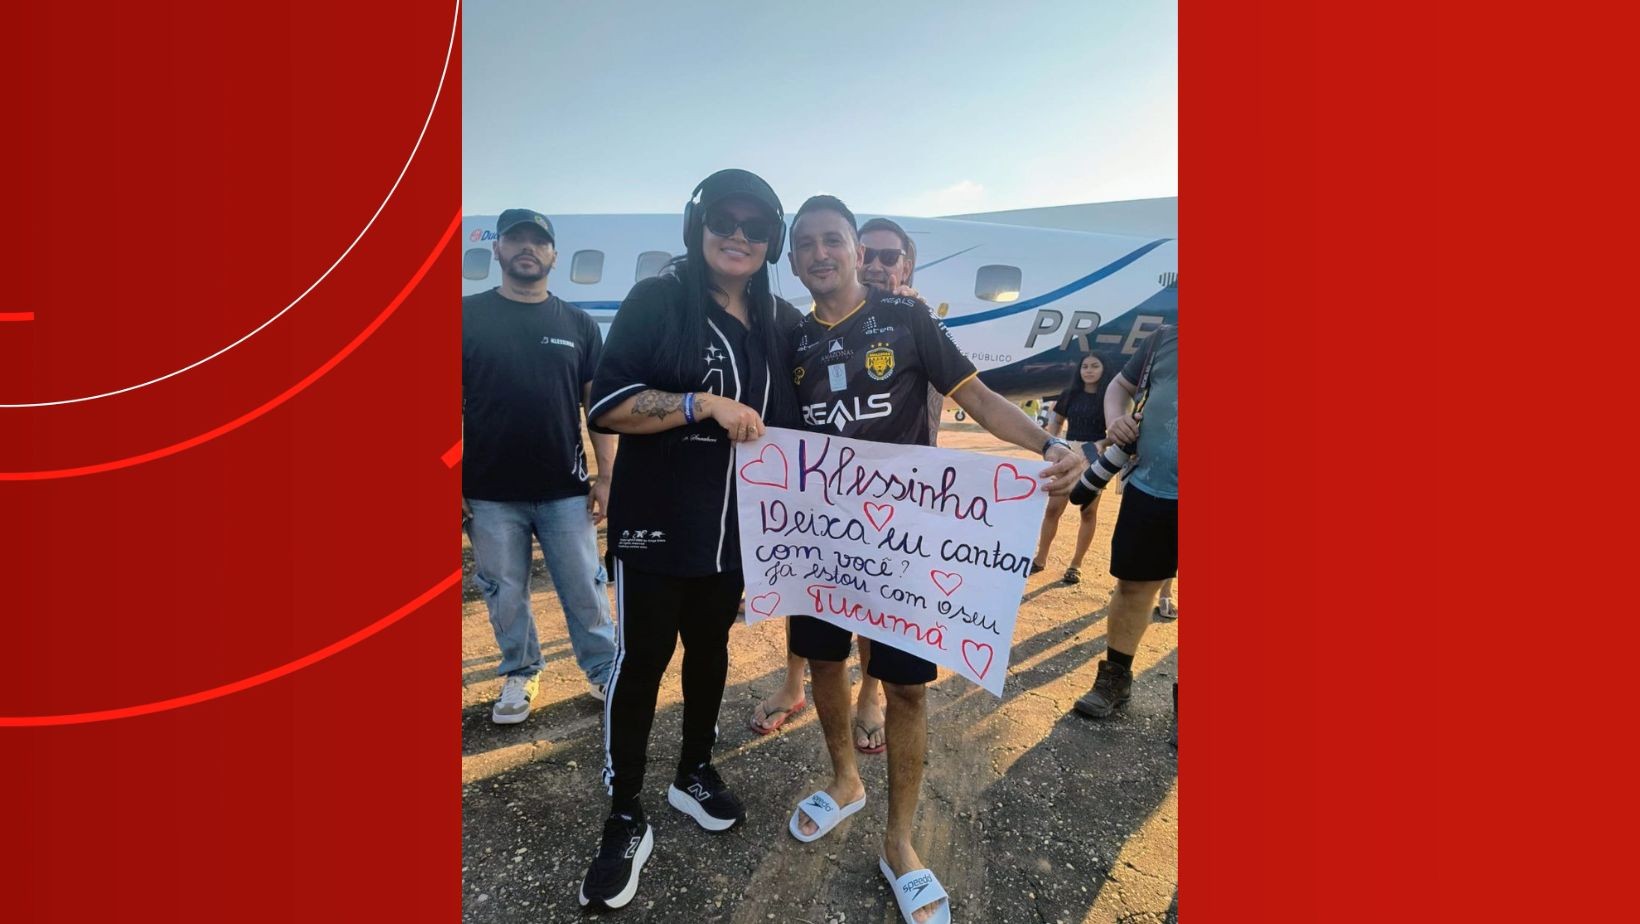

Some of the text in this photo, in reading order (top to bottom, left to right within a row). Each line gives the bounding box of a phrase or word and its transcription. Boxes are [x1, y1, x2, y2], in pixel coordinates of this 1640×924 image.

[971, 352, 1012, 362] PÚBLICO
[802, 392, 893, 431] REALS
[799, 437, 994, 528] Klessinha
[756, 544, 823, 562] com
[760, 500, 1034, 578] Deixa eu cantar
[803, 564, 871, 592] estou
[879, 584, 927, 609] com
[948, 602, 1001, 635] seu
[807, 584, 948, 651] Tucumã
